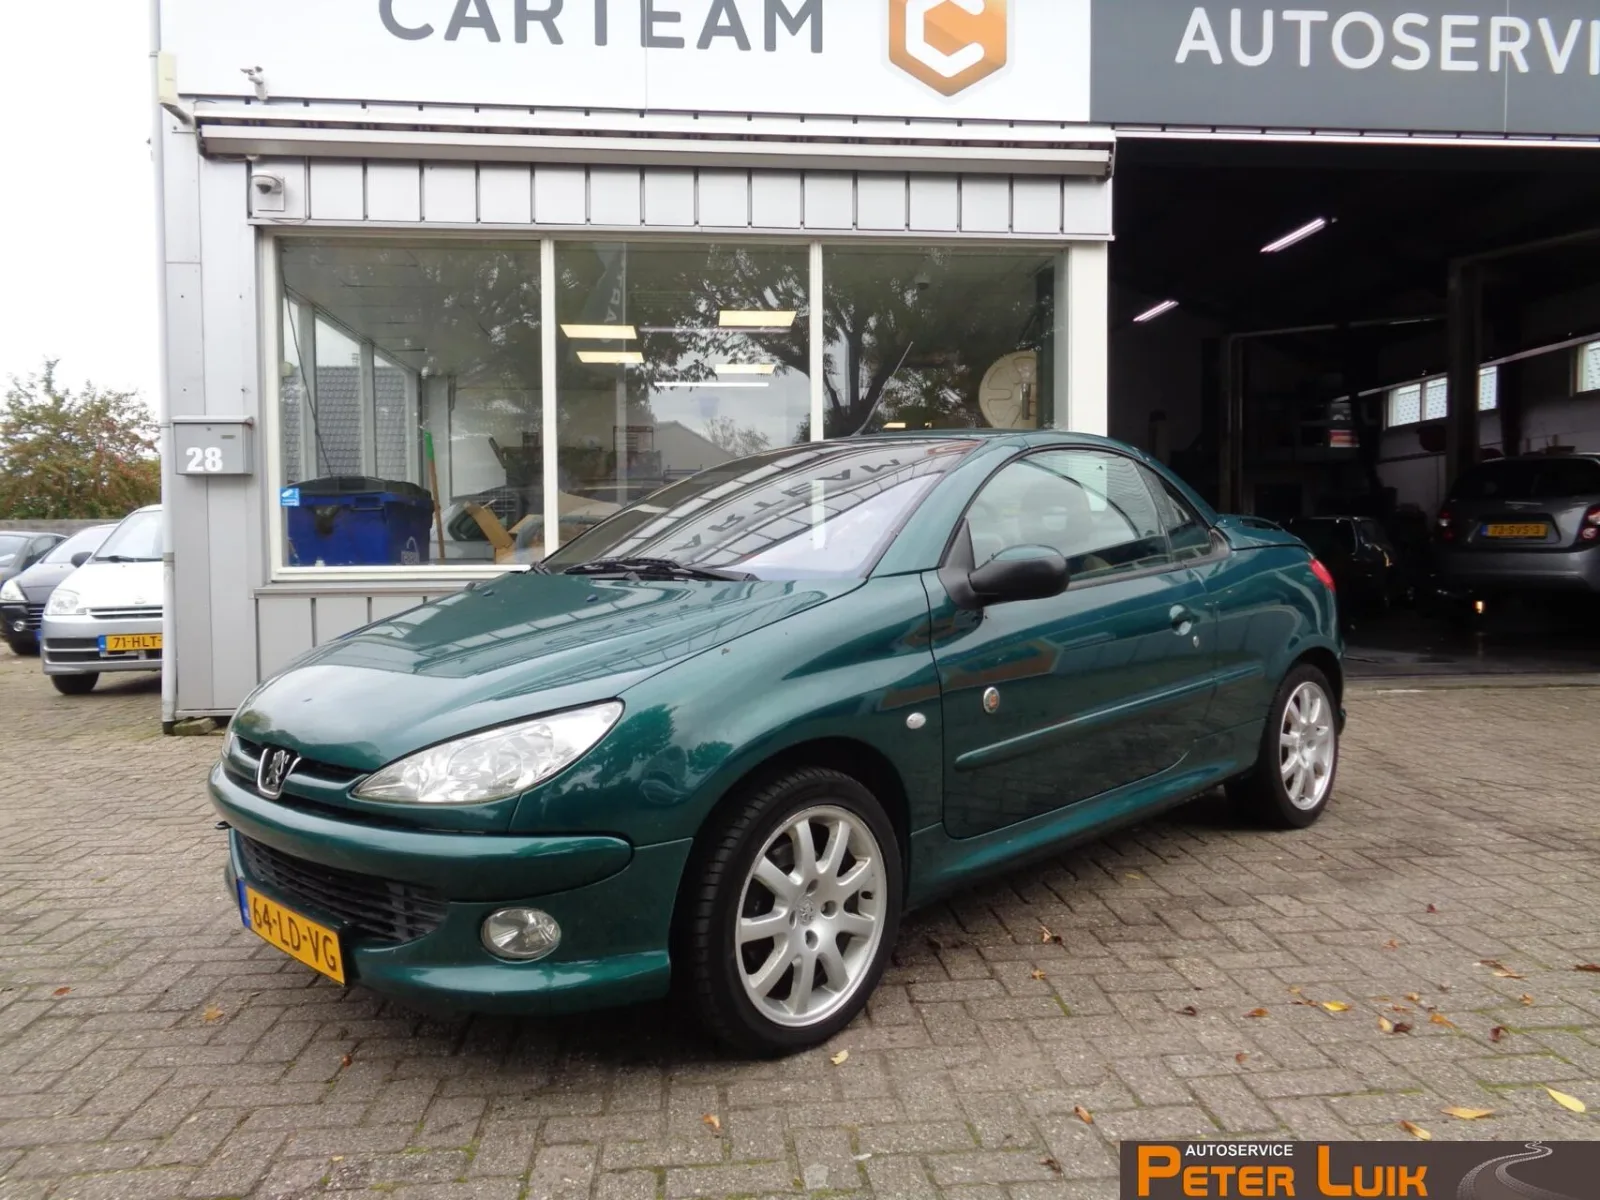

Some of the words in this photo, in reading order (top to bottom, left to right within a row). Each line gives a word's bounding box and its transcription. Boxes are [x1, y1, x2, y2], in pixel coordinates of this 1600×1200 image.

[1175, 7, 1600, 76] AUTOSERVI
[186, 447, 223, 472] 28
[253, 897, 337, 972] 64-LD-VG
